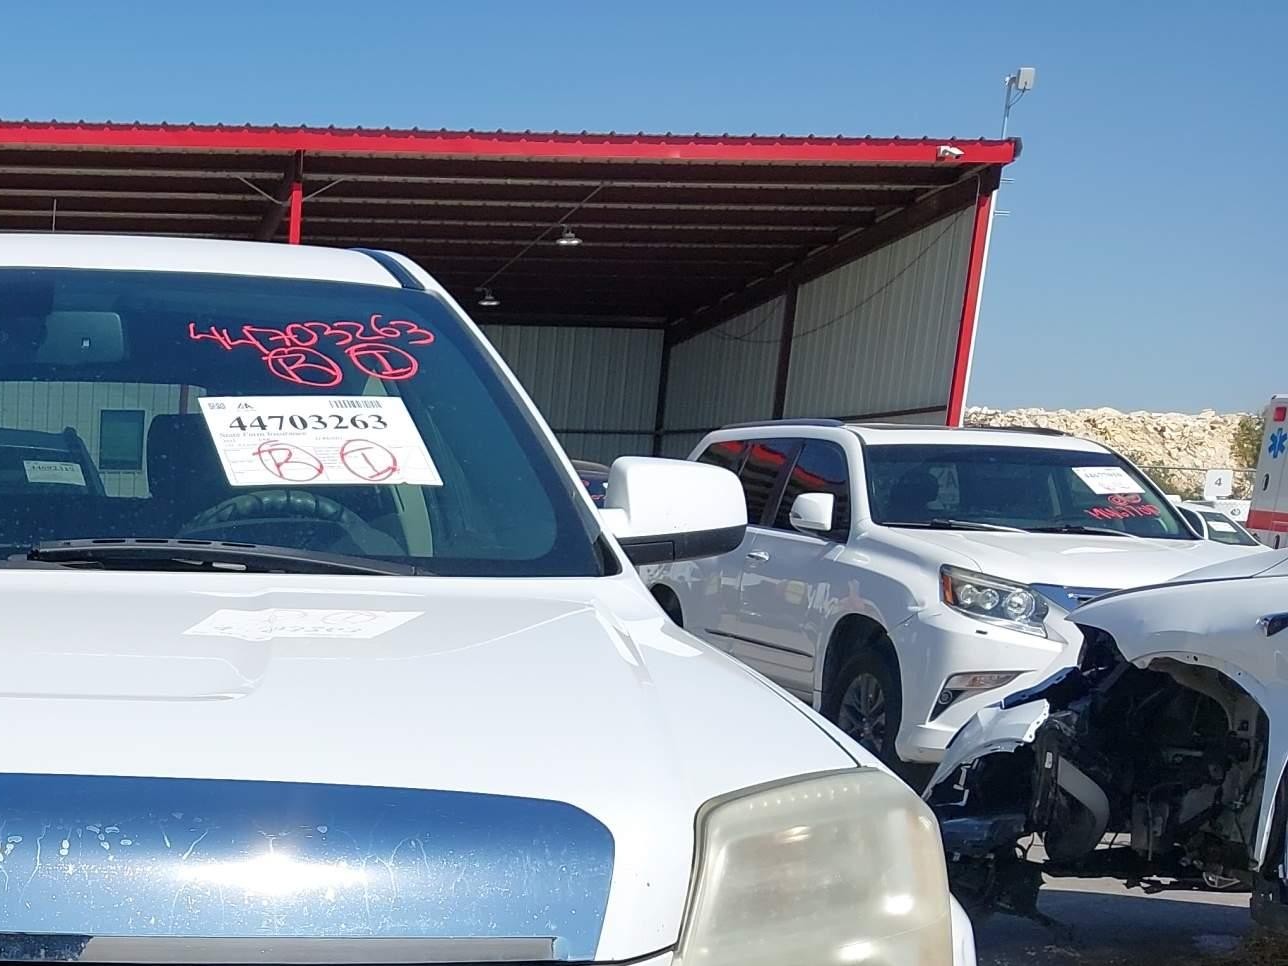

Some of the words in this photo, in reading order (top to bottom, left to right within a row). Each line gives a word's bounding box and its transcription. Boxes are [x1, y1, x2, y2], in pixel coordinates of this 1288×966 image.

[189, 314, 435, 354] 44703263
[228, 414, 389, 431] 44703263
[1214, 477, 1223, 487] 4
